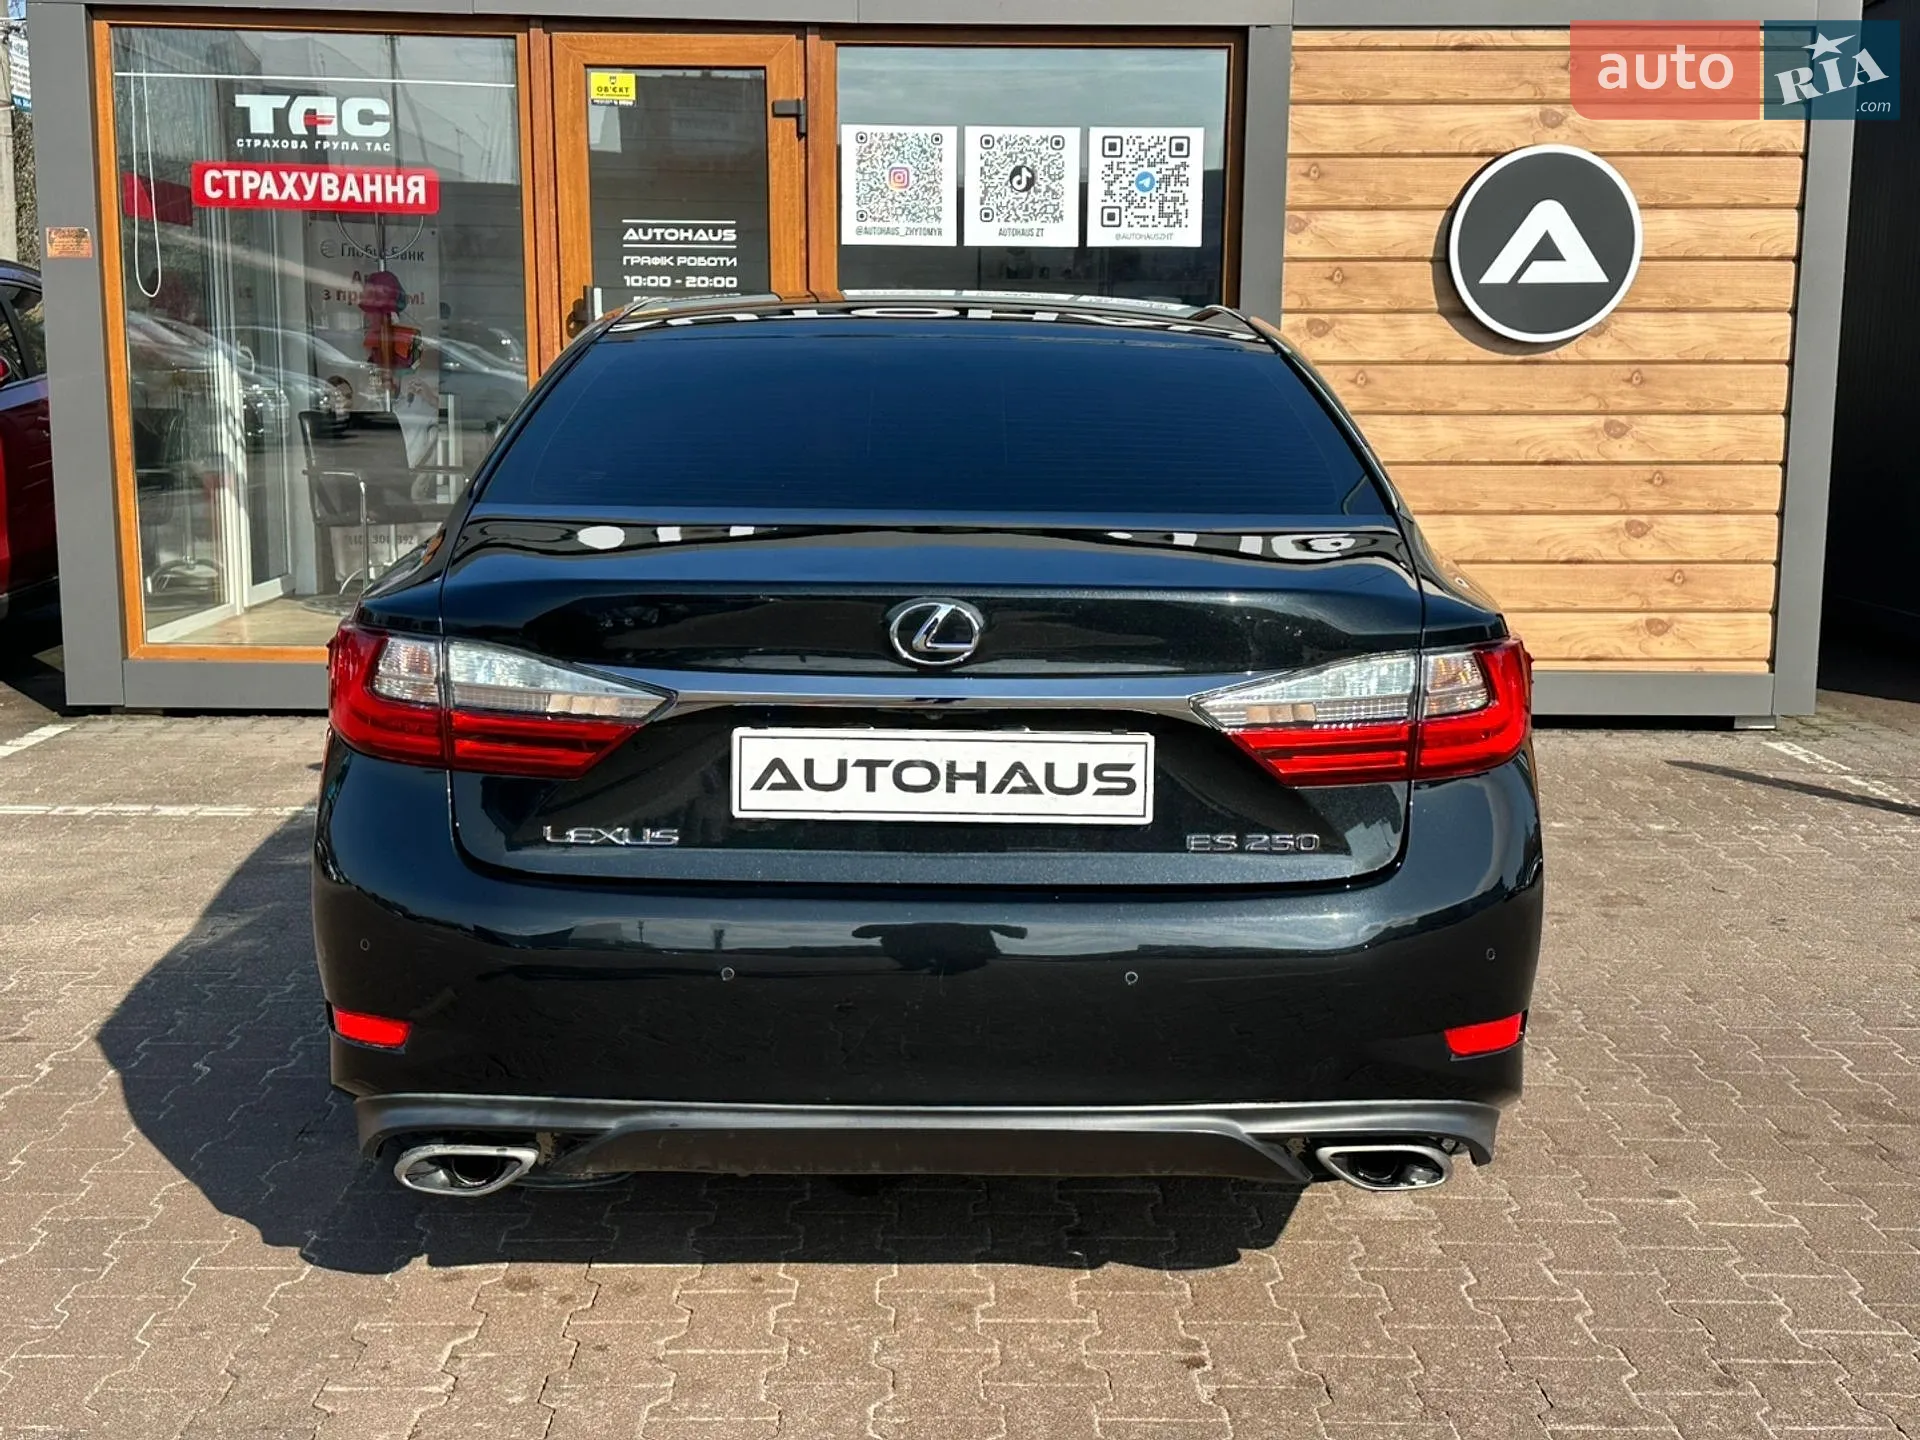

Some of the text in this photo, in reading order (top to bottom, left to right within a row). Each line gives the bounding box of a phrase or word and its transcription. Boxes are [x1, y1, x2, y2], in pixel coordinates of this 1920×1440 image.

[234, 94, 391, 137] ТАС
[236, 138, 392, 152] СТРАХОВА ГРУПА ТАС
[203, 169, 427, 205] СТРАХУВАННЯ
[622, 228, 737, 241] AUTOHAUS
[622, 256, 738, 267] ГРАФІК РОБОТИ
[623, 275, 672, 287] 10:00
[685, 276, 738, 288] 20:00
[749, 756, 1138, 796] AUTOHAUS
[542, 825, 680, 846] LEXUS
[1186, 833, 1321, 852] ES 250
